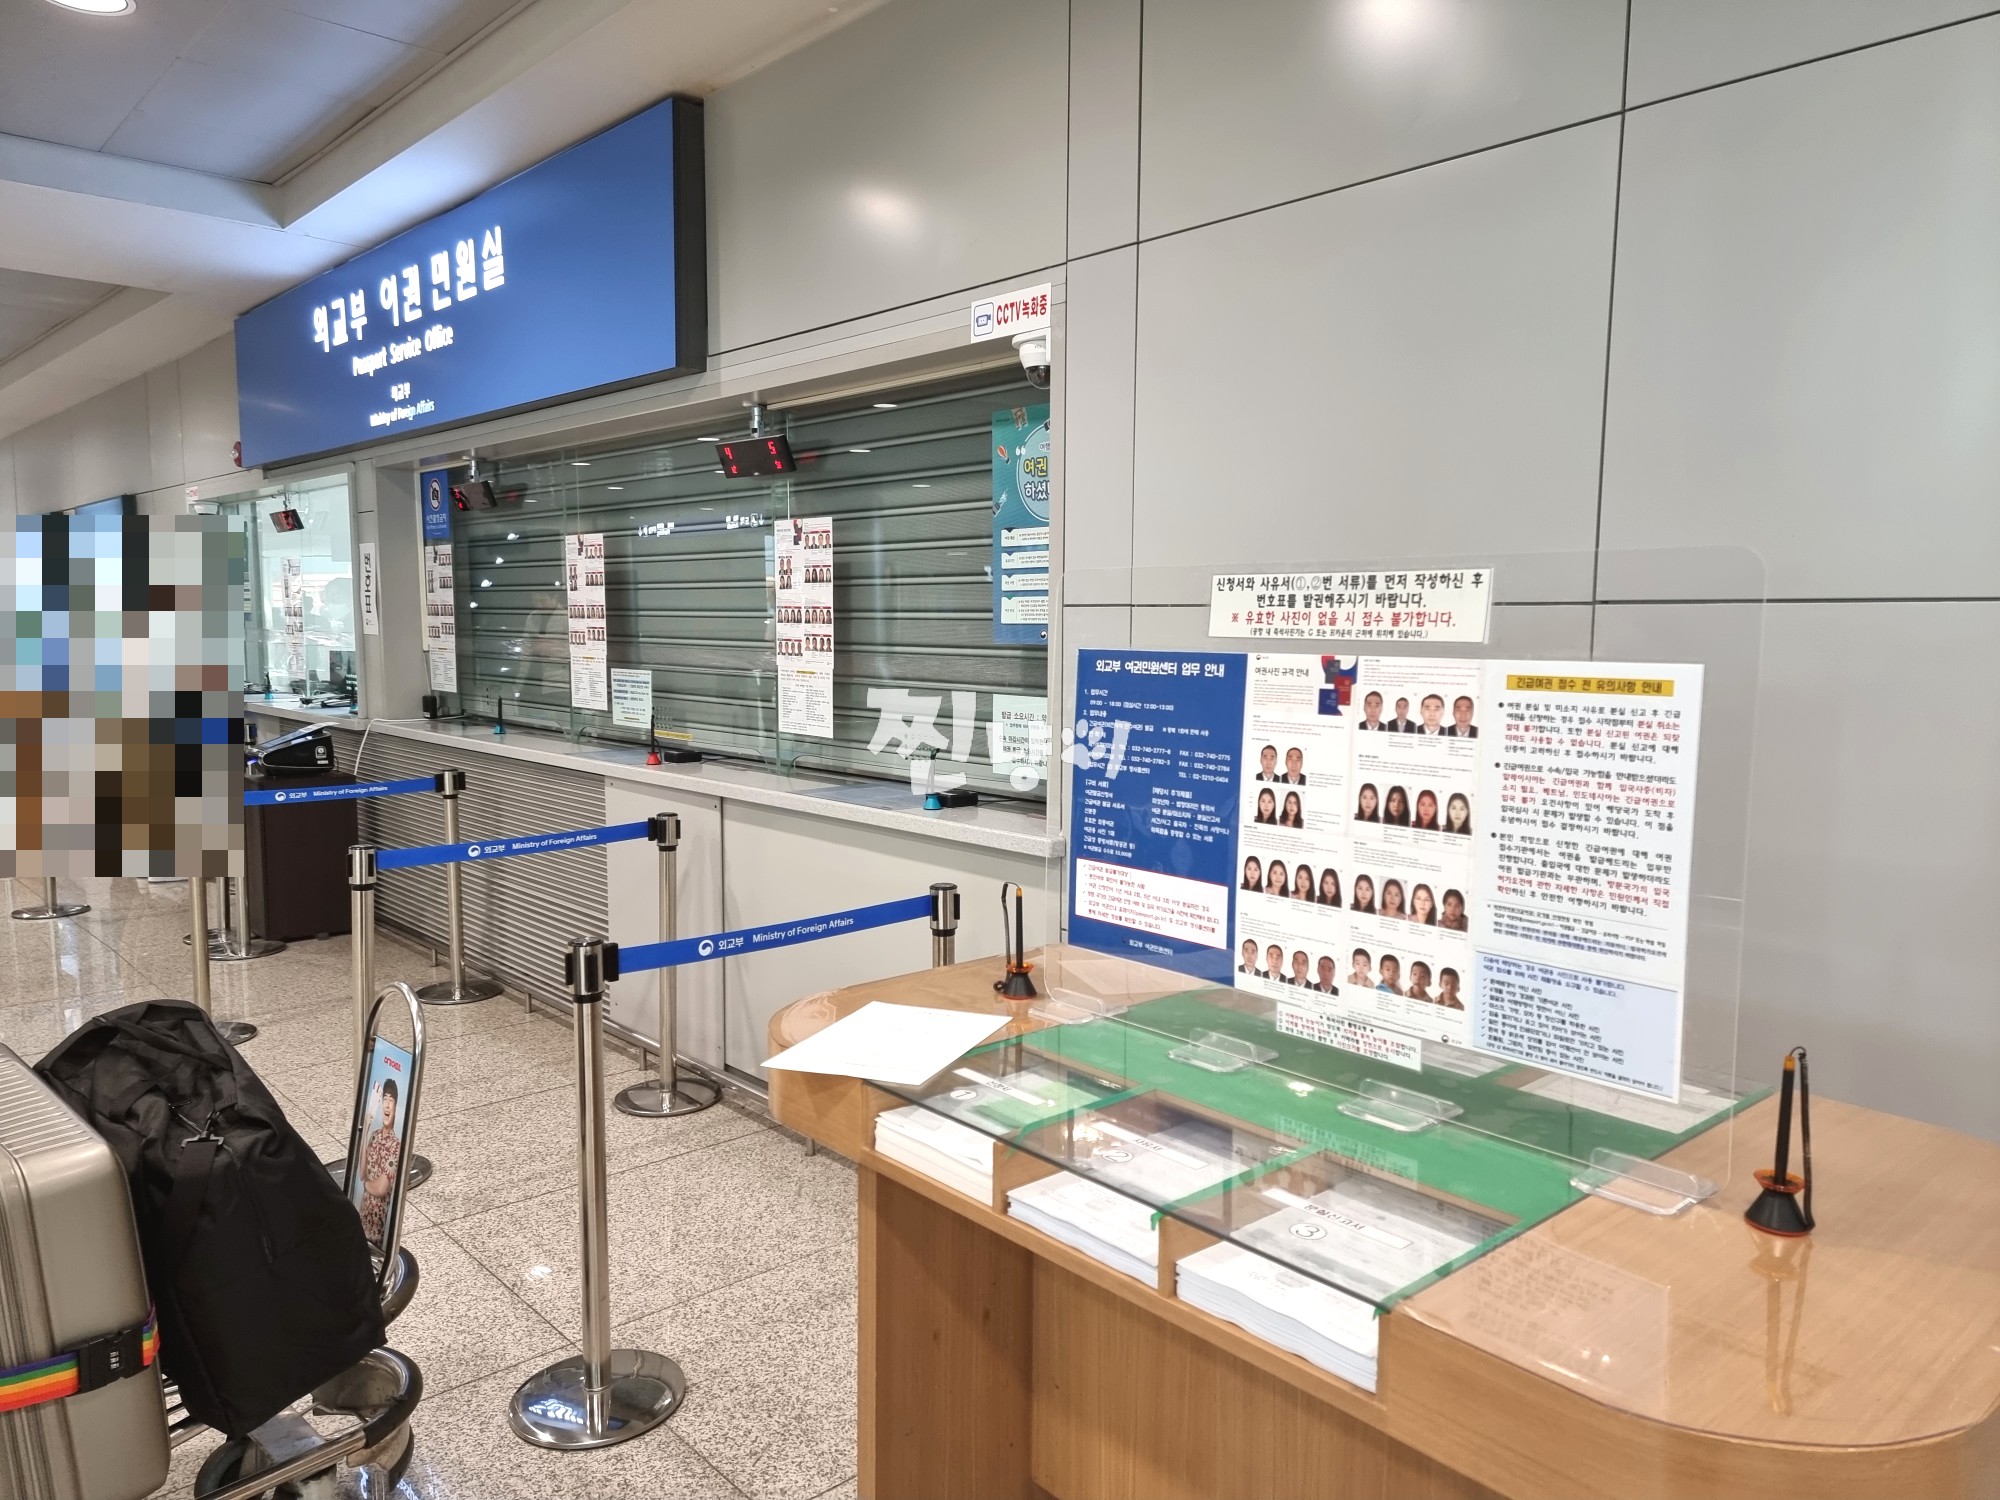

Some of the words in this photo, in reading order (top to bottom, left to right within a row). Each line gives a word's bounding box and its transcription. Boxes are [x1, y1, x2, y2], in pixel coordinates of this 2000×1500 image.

[313, 288, 368, 353] 외교부
[380, 264, 423, 327] 여권
[430, 225, 505, 312] 민원실
[996, 294, 1048, 325] CCTV녹화중
[352, 346, 388, 377] Passport
[390, 335, 422, 365] Service
[424, 324, 454, 352] Office
[416, 399, 435, 415] Affairs
[767, 441, 777, 455] 5
[1215, 576, 1255, 592] 신청서와
[1337, 573, 1377, 591] 서류)를
[1383, 573, 1407, 590] 먼저
[1413, 572, 1464, 589] 작성하신
[1470, 571, 1484, 588] 후
[1255, 593, 1297, 608] 번호표를
[1302, 592, 1368, 608] 발권해주시기
[1374, 591, 1426, 608] 바랍니다.
[1244, 610, 1275, 625] 유효한
[1279, 610, 1311, 625] 사진이
[1316, 610, 1338, 626] 없을
[1344, 610, 1355, 626] 시
[1361, 611, 1384, 626] 접수
[1390, 610, 1456, 627] 불가합니다.
[1096, 659, 1121, 673] 외교부
[1125, 661, 1177, 675] 여권민원센터
[1181, 663, 1200, 676] 업무
[1204, 664, 1225, 678] 안내
[1255, 667, 1280, 676] 여권사진
[1281, 667, 1294, 677] 규격
[1295, 668, 1310, 677] 안내
[1516, 677, 1553, 690] 긴급여권
[1558, 678, 1576, 690] 접수
[1582, 679, 1591, 691] 전
[1596, 680, 1636, 693] 유의사항
[1641, 682, 1663, 694] 안내
[288, 791, 307, 799] 외교부
[313, 788, 337, 797] Ministry
[345, 787, 368, 796] Foreign
[369, 785, 388, 793] Affairs
[483, 843, 506, 854] 외교부
[512, 840, 539, 851] Ministry
[540, 839, 548, 848] of
[548, 837, 575, 848] Foreign
[576, 833, 597, 843] Affairs
[752, 929, 786, 944] Ministry
[787, 928, 796, 937] of
[796, 923, 828, 937] Foreign
[828, 917, 854, 930] Affairs
[718, 937, 745, 951] 외교부
